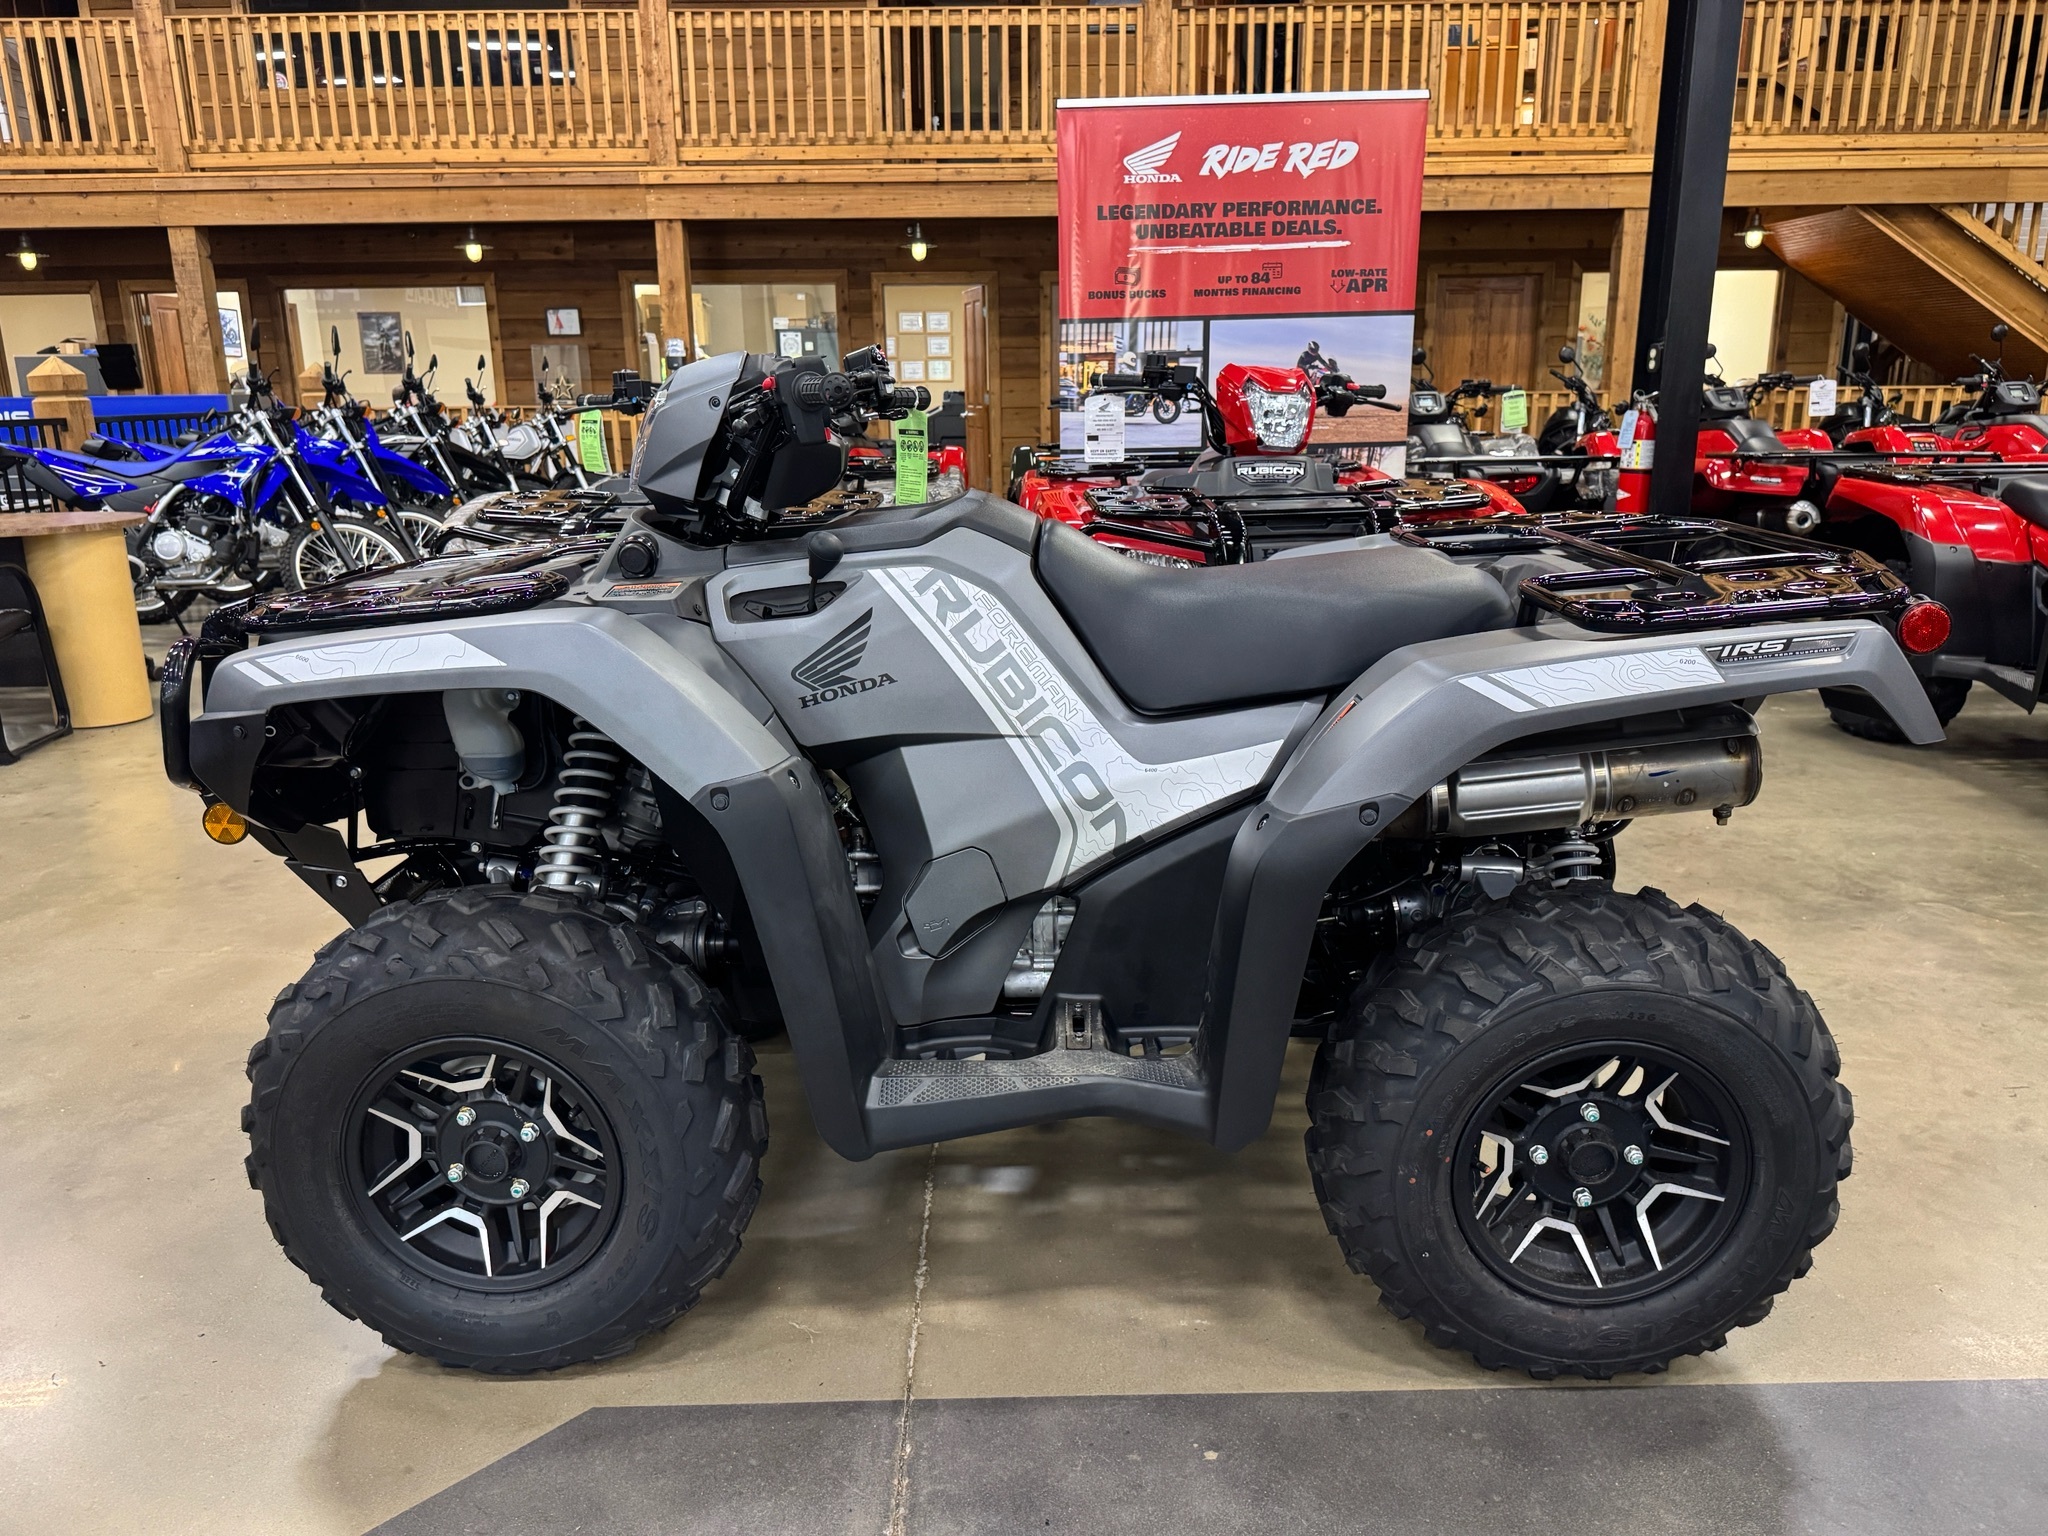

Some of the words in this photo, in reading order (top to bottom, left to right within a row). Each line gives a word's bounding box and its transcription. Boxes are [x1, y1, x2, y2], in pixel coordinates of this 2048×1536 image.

[1199, 141, 1284, 179] RIDE
[1284, 138, 1360, 179] RED
[1123, 174, 1183, 184] HONDA
[1097, 202, 1217, 221] LEGENDARY
[1222, 198, 1383, 218] PERFORMANCE.
[1135, 220, 1266, 240] UNBEATABLE
[1271, 219, 1343, 236] DEALS.
[1217, 275, 1232, 284] UP
[1235, 275, 1249, 284] TO
[1251, 272, 1271, 285] 84
[1331, 268, 1388, 278] LOW-RATE
[1193, 287, 1239, 297] MONTHS
[1242, 286, 1301, 296] FINANCING
[1346, 278, 1388, 293] APR
[1088, 290, 1126, 300] BONUS
[1129, 289, 1167, 299] BUCKS
[1236, 466, 1305, 476] RUBICON
[974, 589, 1078, 722] FOREMAN
[1721, 639, 1788, 658] IRS
[1679, 657, 1697, 666] 6200
[798, 672, 899, 710] HONDA
[913, 567, 1130, 853] RUBICON
